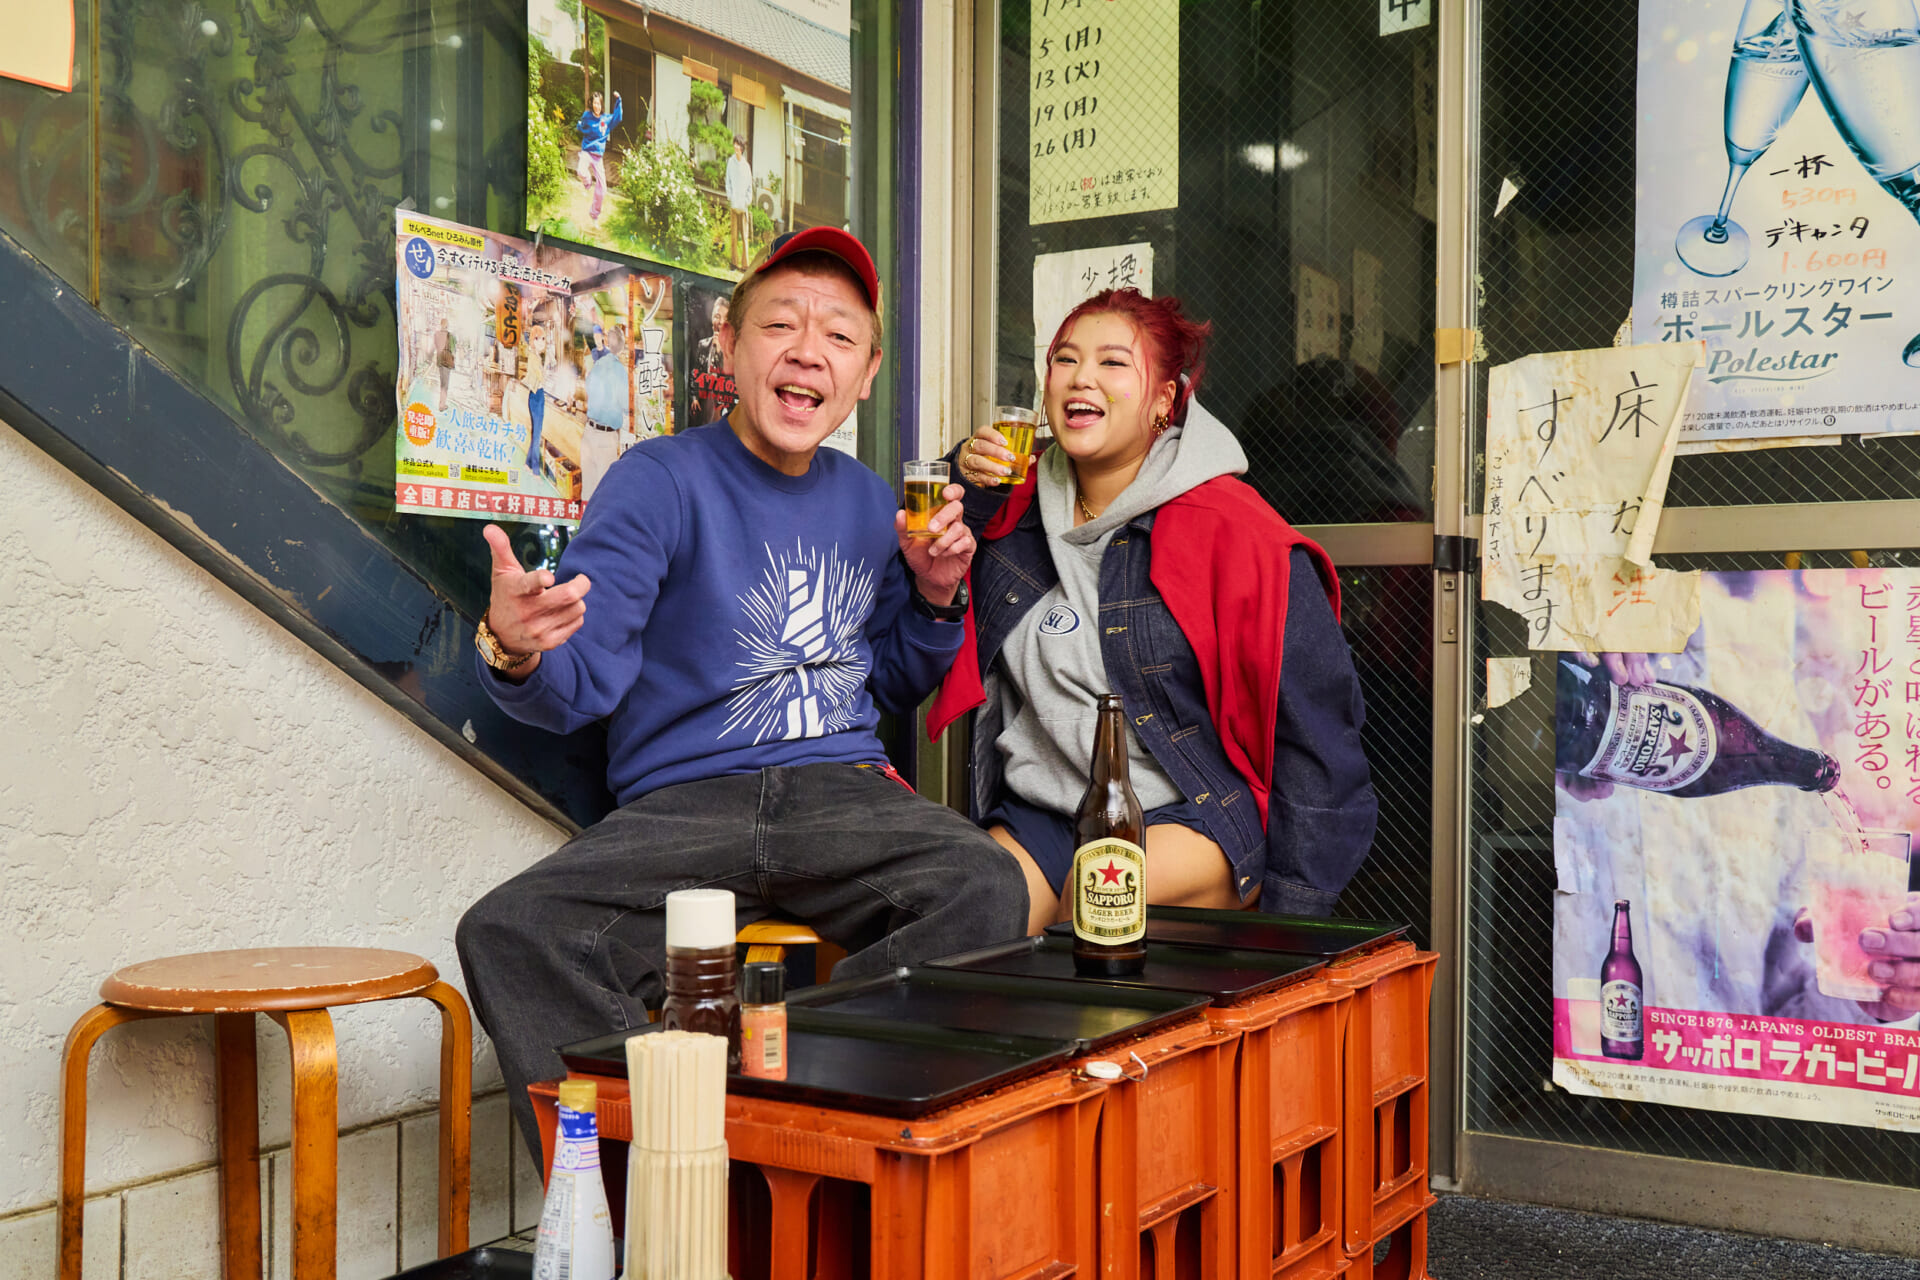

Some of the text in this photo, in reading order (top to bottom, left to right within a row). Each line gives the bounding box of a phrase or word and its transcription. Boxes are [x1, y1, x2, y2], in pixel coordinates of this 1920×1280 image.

[1769, 155, 1834, 178] 一杯
[1782, 187, 1857, 209] 530円
[1766, 217, 1870, 248] デキャンタ
[1660, 277, 1894, 309] 樽詰スパークリングワイン
[1662, 303, 1893, 342] ポールスター
[637, 278, 669, 440] ソロ酔い
[1707, 347, 1839, 375] Polestar
[1518, 389, 1574, 648] すべります
[1606, 568, 1657, 618] 注
[1854, 582, 1893, 790] ビールがある。
[1632, 704, 1663, 772] SAPPORO
[1087, 892, 1134, 906] SAPPORO
[1088, 907, 1134, 917] LAGER BEER
[1741, 1020, 1805, 1036] JAPAN'S
[1812, 1025, 1877, 1043] OLDEST
[1884, 1033, 1920, 1048] BRA
